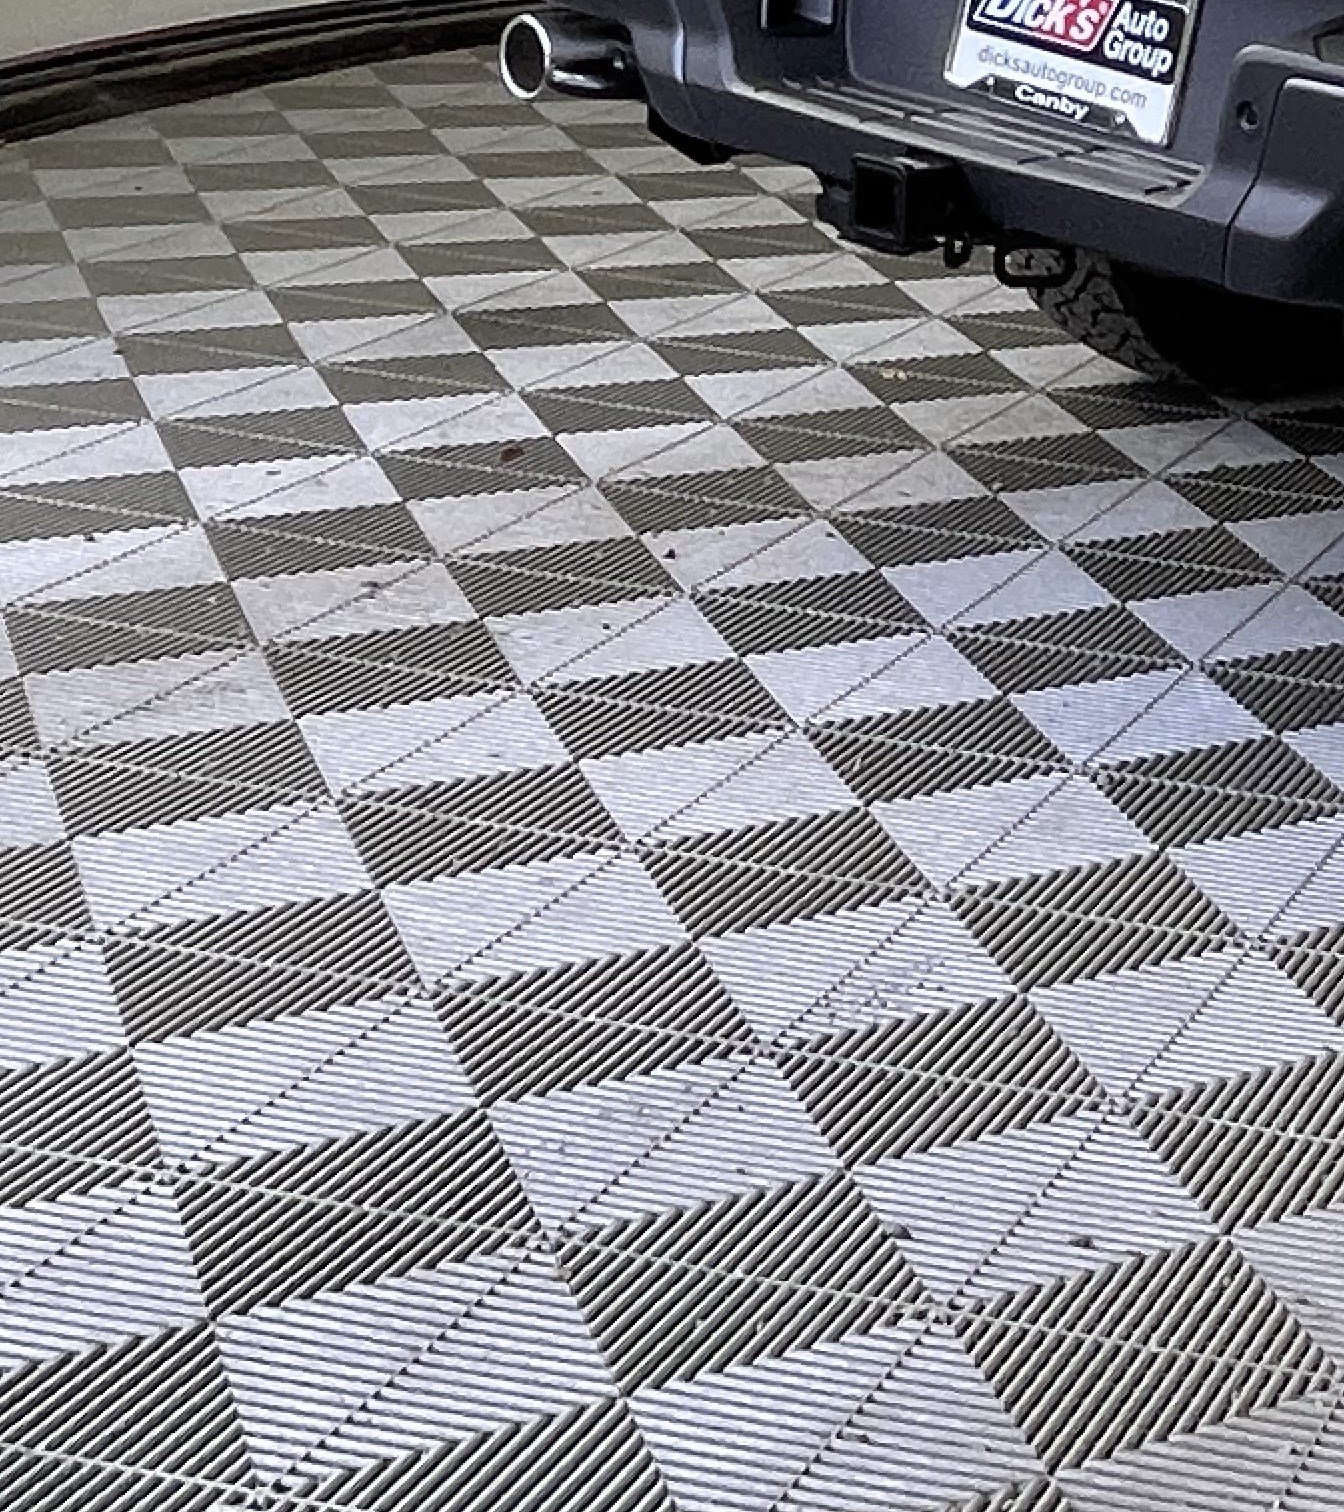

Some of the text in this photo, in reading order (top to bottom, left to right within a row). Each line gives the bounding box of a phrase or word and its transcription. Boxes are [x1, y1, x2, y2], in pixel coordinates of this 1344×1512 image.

[1114, 1, 1170, 42] Auto
[977, 44, 1148, 110] dicksautogroup.com
[1103, 33, 1174, 78] Group
[1014, 84, 1090, 120] Canby
